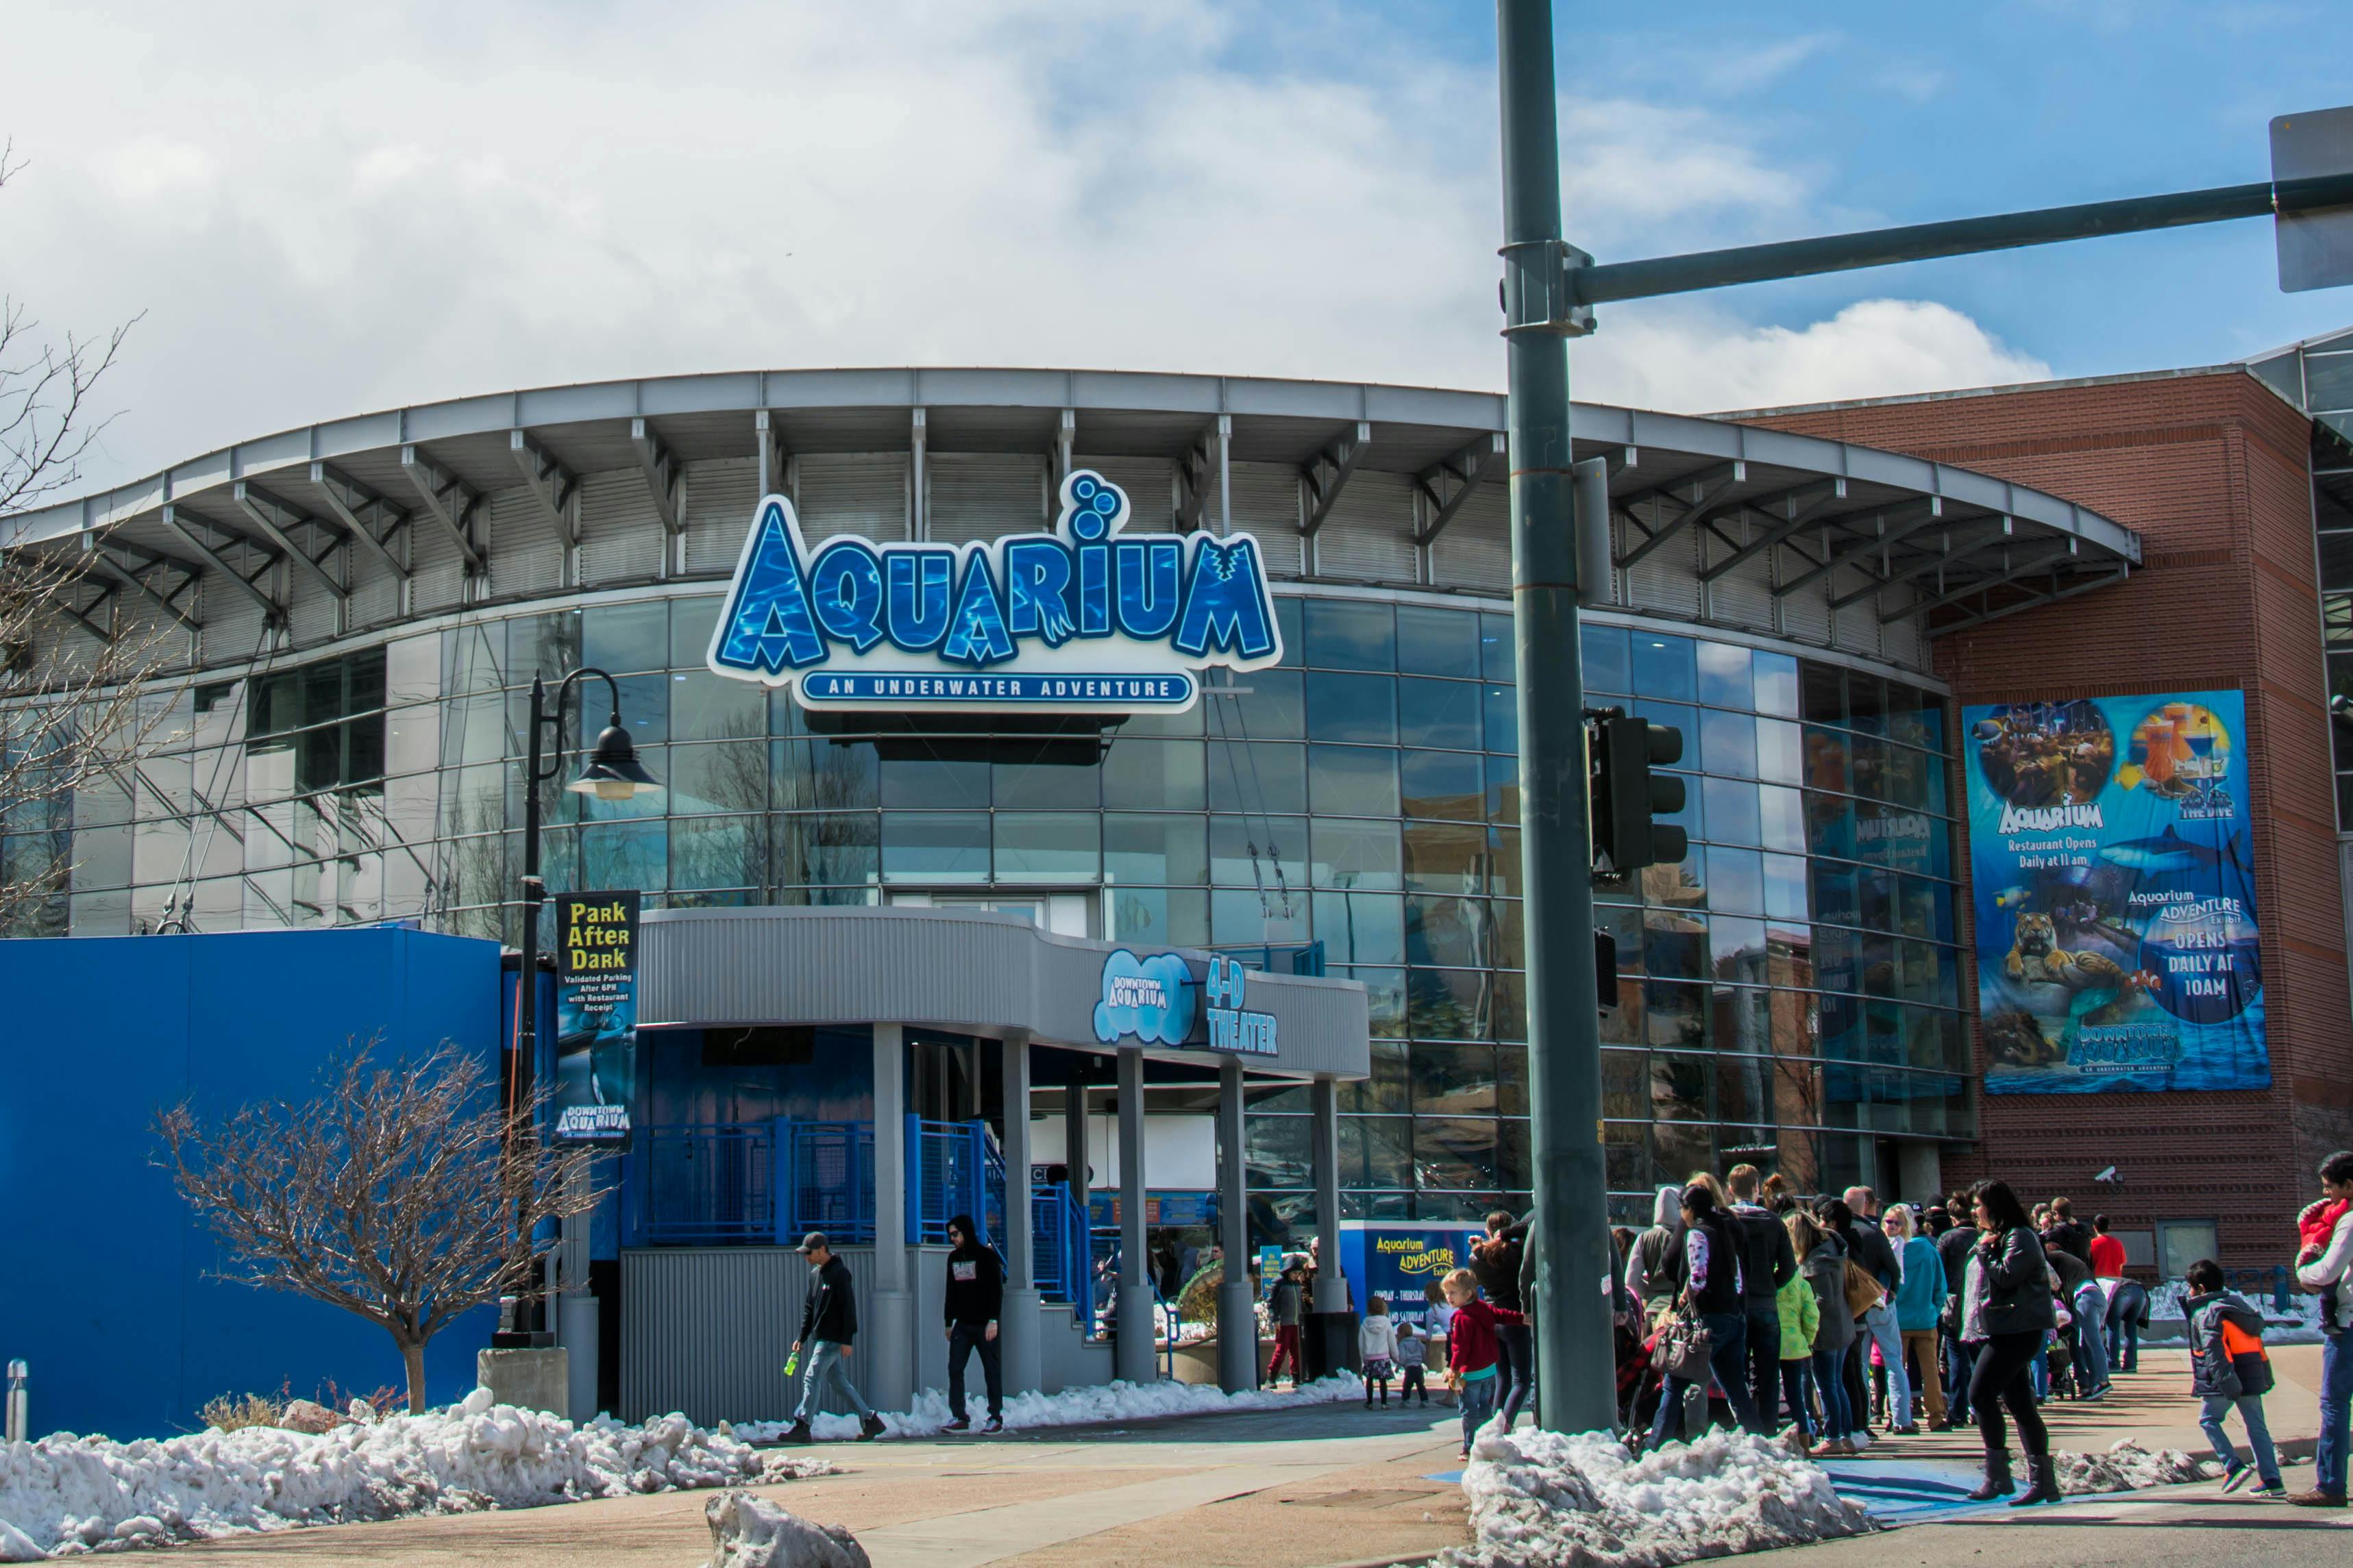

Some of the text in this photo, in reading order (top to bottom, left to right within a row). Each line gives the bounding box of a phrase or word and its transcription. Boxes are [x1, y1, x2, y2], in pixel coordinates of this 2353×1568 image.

[715, 475, 1275, 675] AQUARIUM
[829, 679, 1170, 697] AN UNDERWATER ADVENTURE
[1997, 791, 2104, 834] AQUARIUM
[2008, 836, 2097, 852] Restaurant Opens
[2019, 855, 2045, 869] Daily
[2047, 856, 2058, 867] at
[2071, 856, 2088, 866] am
[2128, 890, 2194, 906] Aquarium
[2160, 897, 2241, 919] ADVENTURE
[2210, 916, 2241, 924] Exibit
[2175, 931, 2226, 949] OPENS
[2168, 954, 2234, 973] DAILY AT
[565, 973, 632, 984] Validated Parking
[1113, 975, 1161, 991] DOWNTOWN
[1207, 958, 1245, 1010] 4-D
[2184, 978, 2227, 996] 10AM
[580, 983, 617, 993] After 6PM
[1107, 982, 1167, 1009] AQUARIUM
[568, 993, 629, 1003] with Restaurant
[584, 1004, 613, 1012] Receipt
[1207, 1008, 1279, 1054] THEATER
[2080, 1024, 2171, 1041] DOWNTOWN
[2066, 1033, 2183, 1067] AQUARIUM
[567, 1105, 625, 1117] DOWNTOWN
[556, 1111, 630, 1132] AQUARIUM
[1377, 1236, 1423, 1254] Aquarium
[1400, 1248, 1454, 1270] ADVENTURE
[1399, 1310, 1425, 1322] SATURDAY
